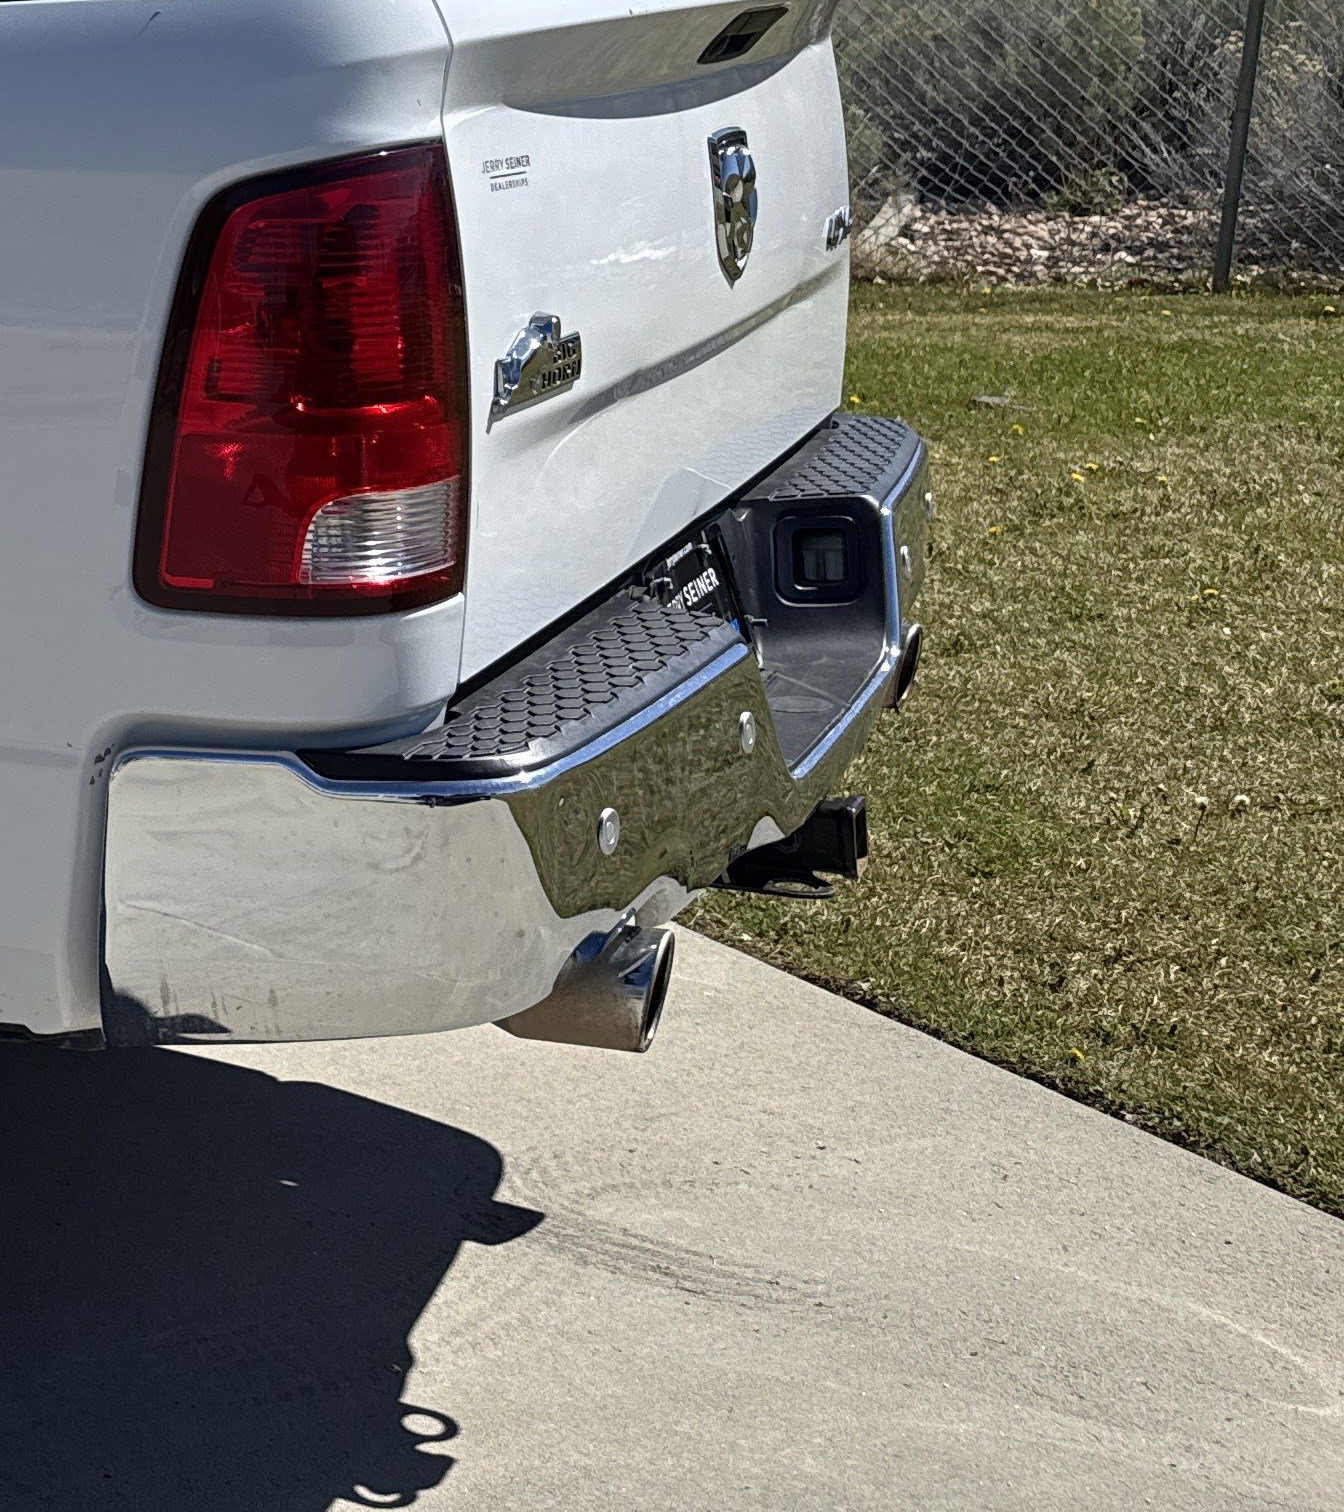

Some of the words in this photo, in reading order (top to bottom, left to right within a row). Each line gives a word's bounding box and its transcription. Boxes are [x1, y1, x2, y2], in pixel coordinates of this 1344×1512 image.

[481, 158, 504, 174] JERRY
[505, 155, 530, 170] SEINER
[490, 178, 528, 192] DEALERSHIPS
[553, 339, 577, 363] BIG
[542, 358, 581, 389] HORN
[683, 567, 720, 607] SEINER
